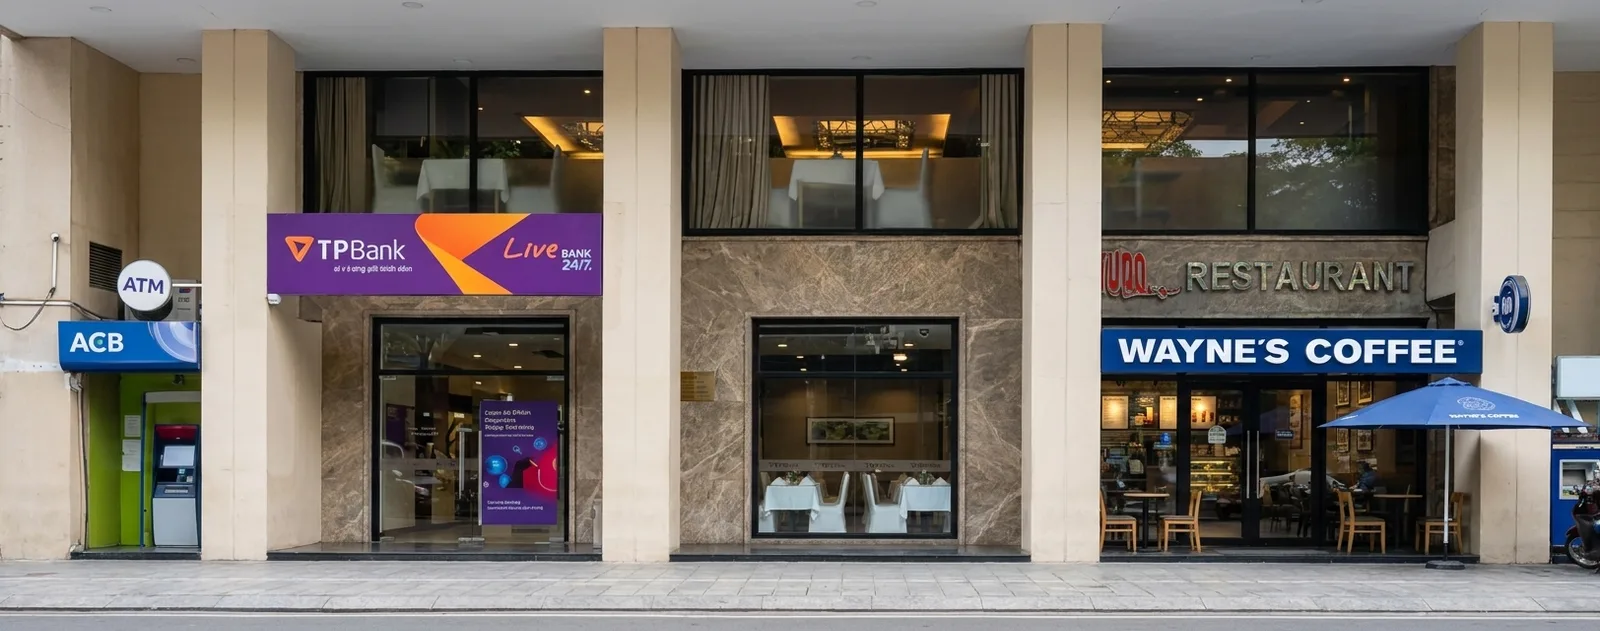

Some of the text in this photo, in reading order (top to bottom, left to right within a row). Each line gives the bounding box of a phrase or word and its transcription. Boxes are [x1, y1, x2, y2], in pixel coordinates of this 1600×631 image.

[317, 239, 406, 260] TPBank
[503, 237, 592, 259] Live BANK
[122, 276, 165, 295] ATM
[1185, 261, 1415, 292] RESTAURANT
[69, 332, 124, 353] ACB
[1118, 338, 1290, 363] WAYNE'S
